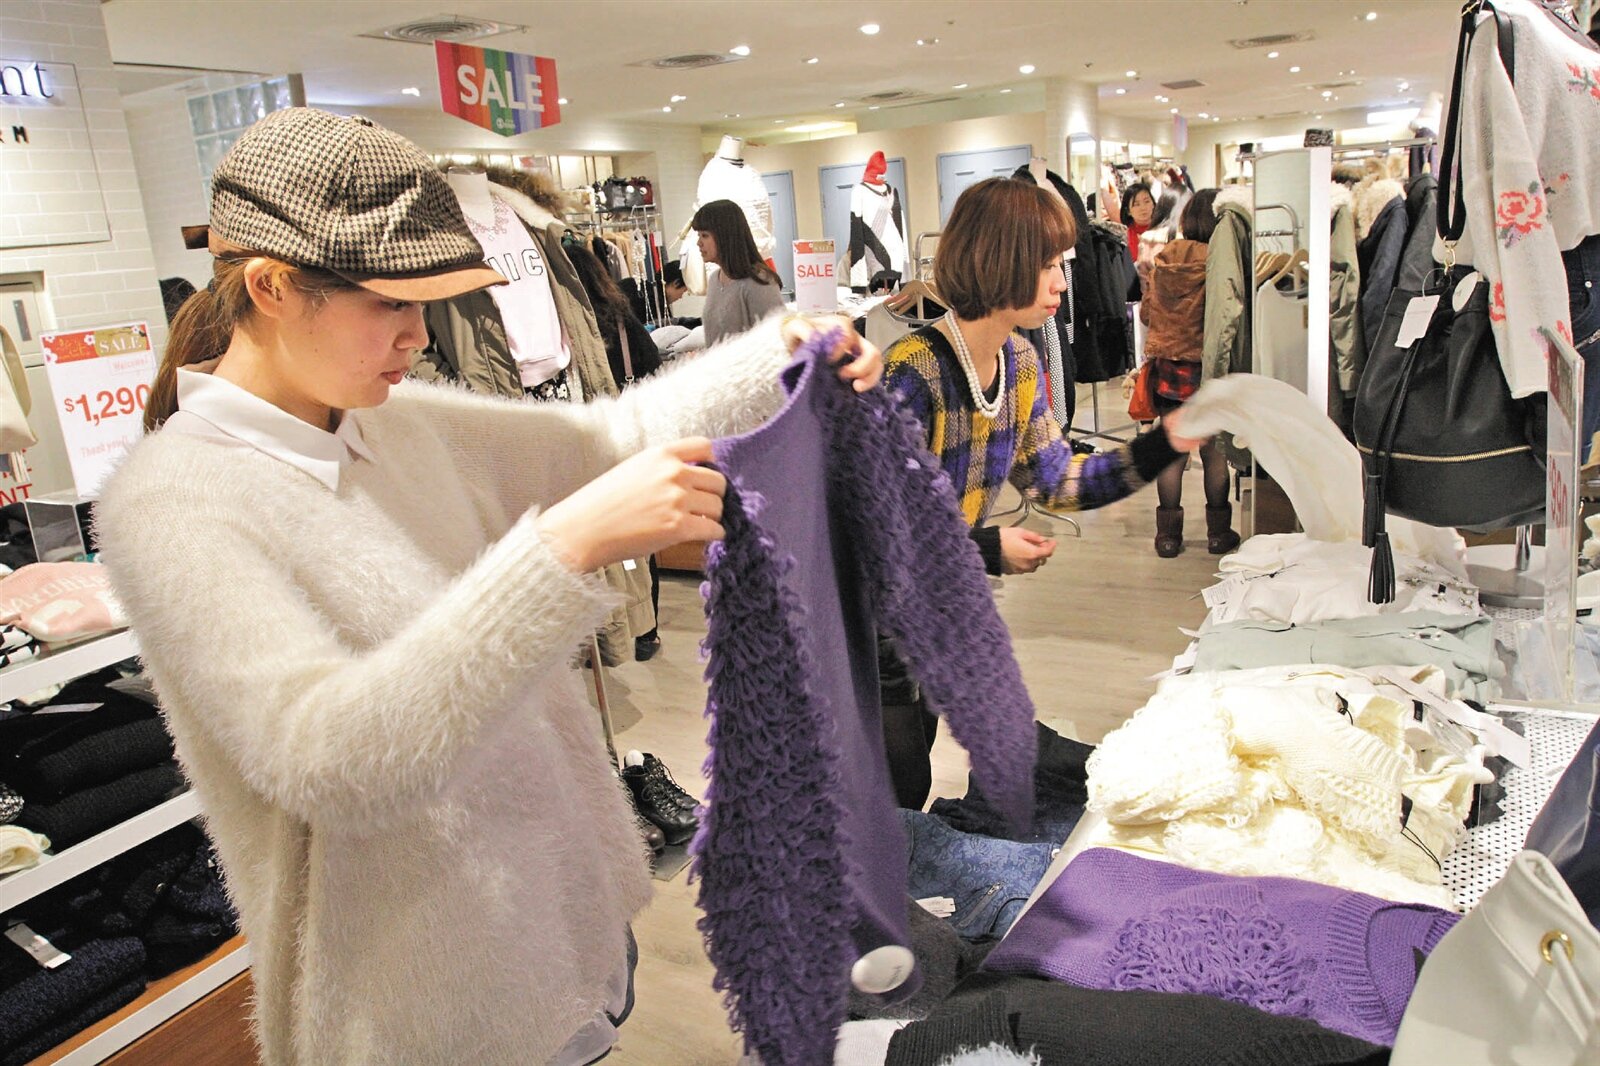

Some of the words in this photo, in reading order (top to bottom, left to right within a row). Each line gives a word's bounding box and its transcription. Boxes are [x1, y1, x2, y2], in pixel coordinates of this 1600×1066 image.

[456, 64, 546, 113] SALE
[797, 264, 834, 278] SALE
[99, 337, 143, 353] SALE
